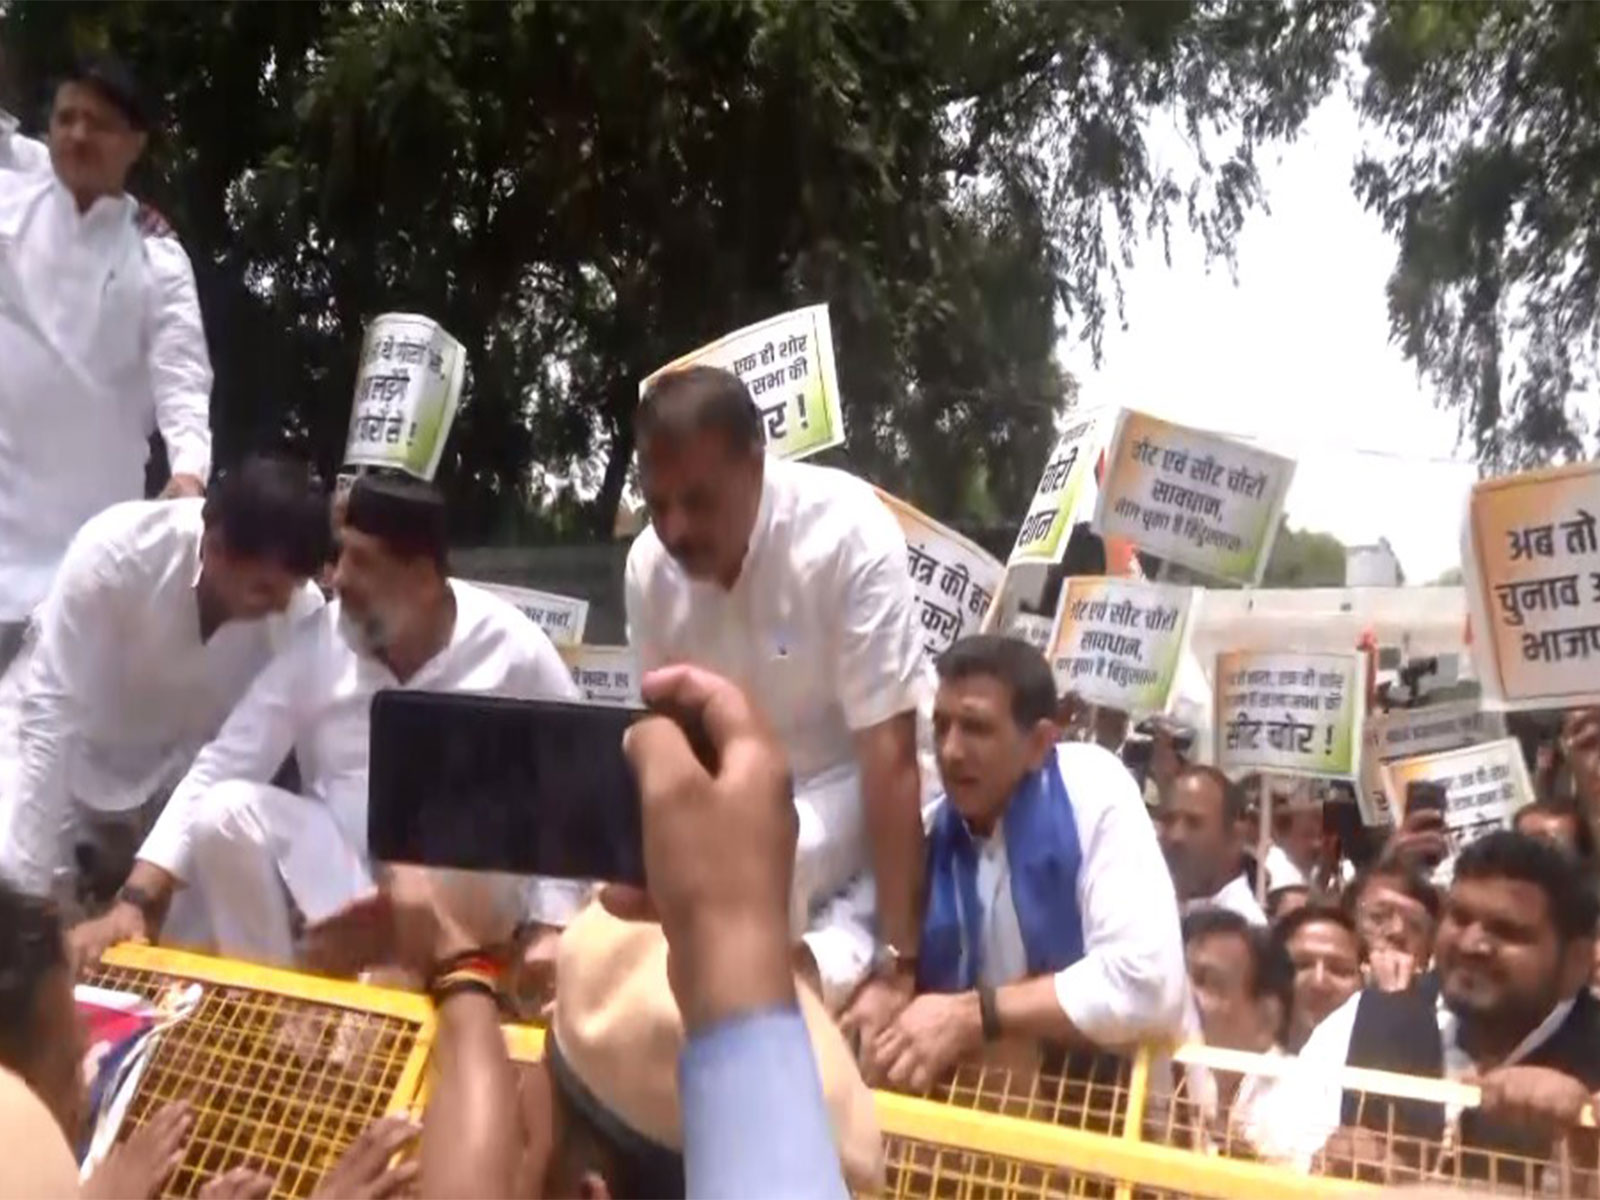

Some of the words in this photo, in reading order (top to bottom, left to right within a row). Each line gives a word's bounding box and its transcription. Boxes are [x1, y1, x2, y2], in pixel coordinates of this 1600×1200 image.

[759, 341, 775, 367] ही
[778, 334, 808, 358] शोर
[751, 368, 786, 395] सभा
[789, 356, 809, 382] की
[759, 401, 788, 439] र
[1506, 524, 1554, 563] अब
[1559, 508, 1598, 554] तो
[907, 543, 940, 586] तंत्र
[940, 562, 970, 602] की
[920, 600, 964, 642] करो
[1494, 574, 1580, 626] चुनाव
[1226, 711, 1263, 749] सीट
[1267, 713, 1315, 754] चोर
